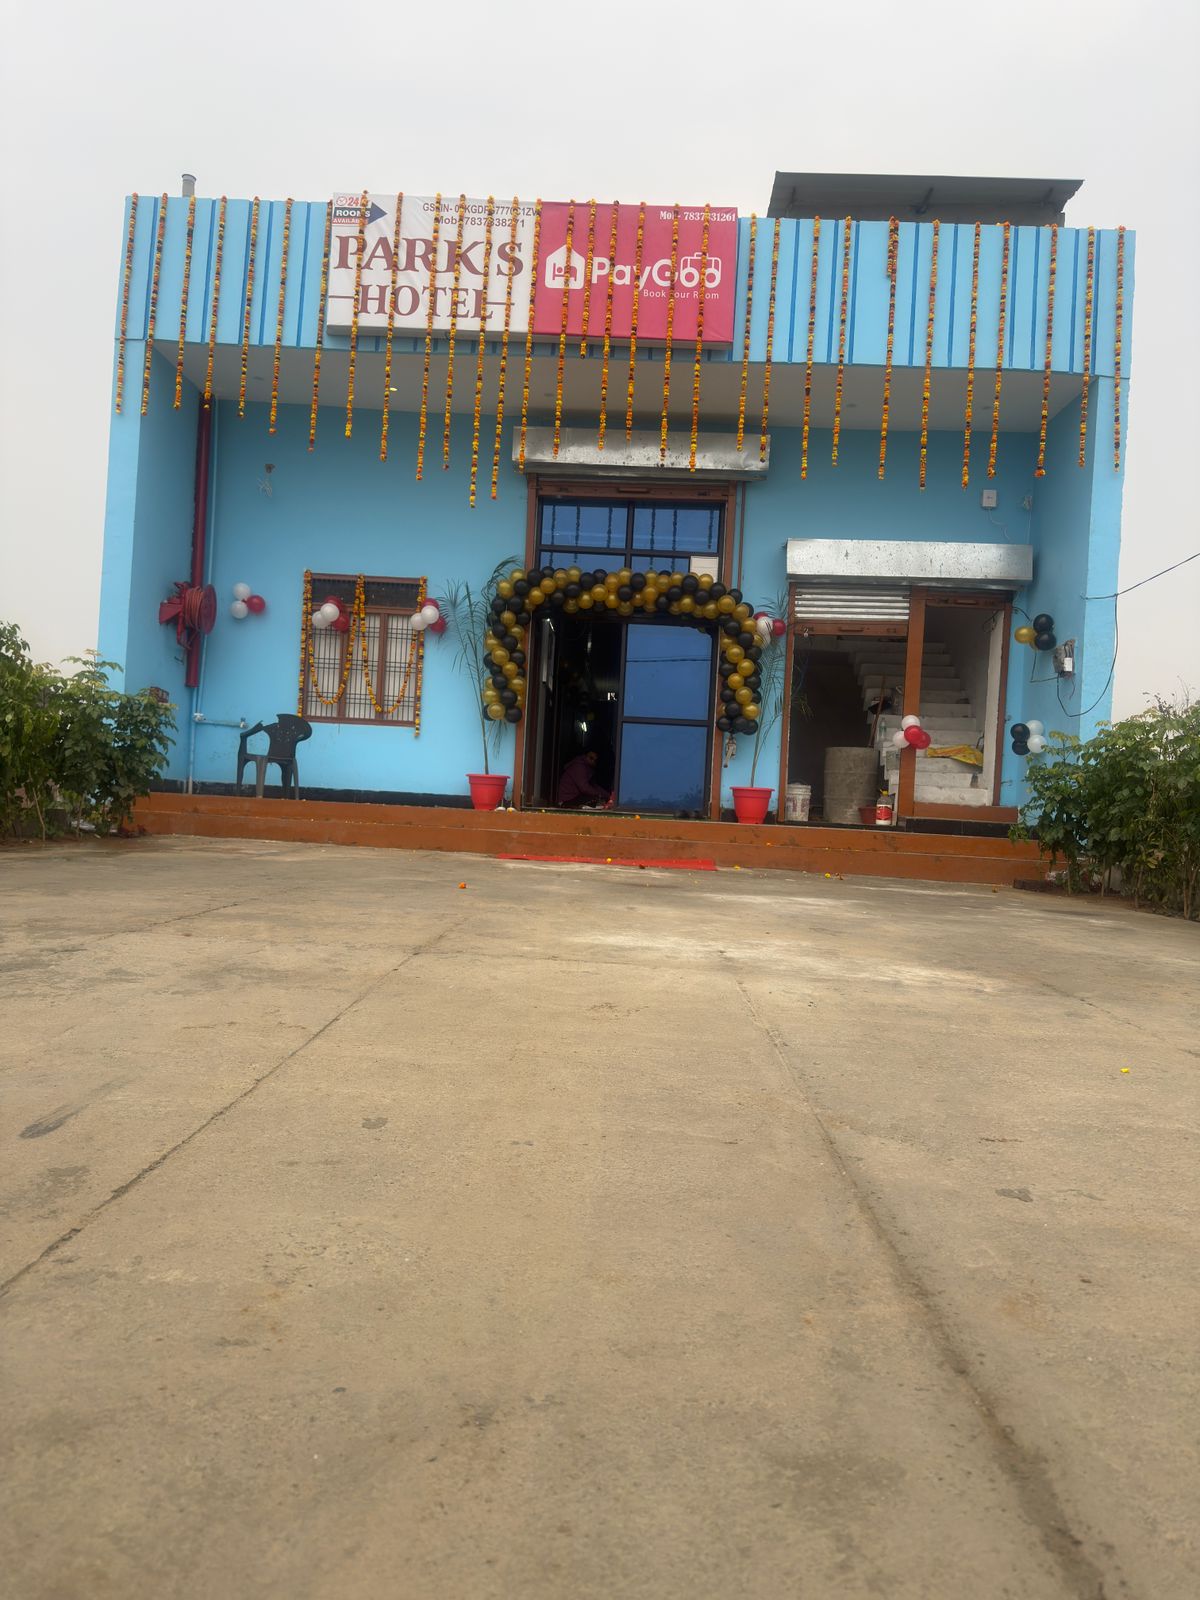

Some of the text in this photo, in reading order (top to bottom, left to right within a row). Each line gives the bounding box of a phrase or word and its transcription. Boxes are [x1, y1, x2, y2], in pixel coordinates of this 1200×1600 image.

[683, 211, 736, 222] 783731261
[643, 289, 720, 300] Book our Rom
[358, 284, 494, 319] HOTEL
